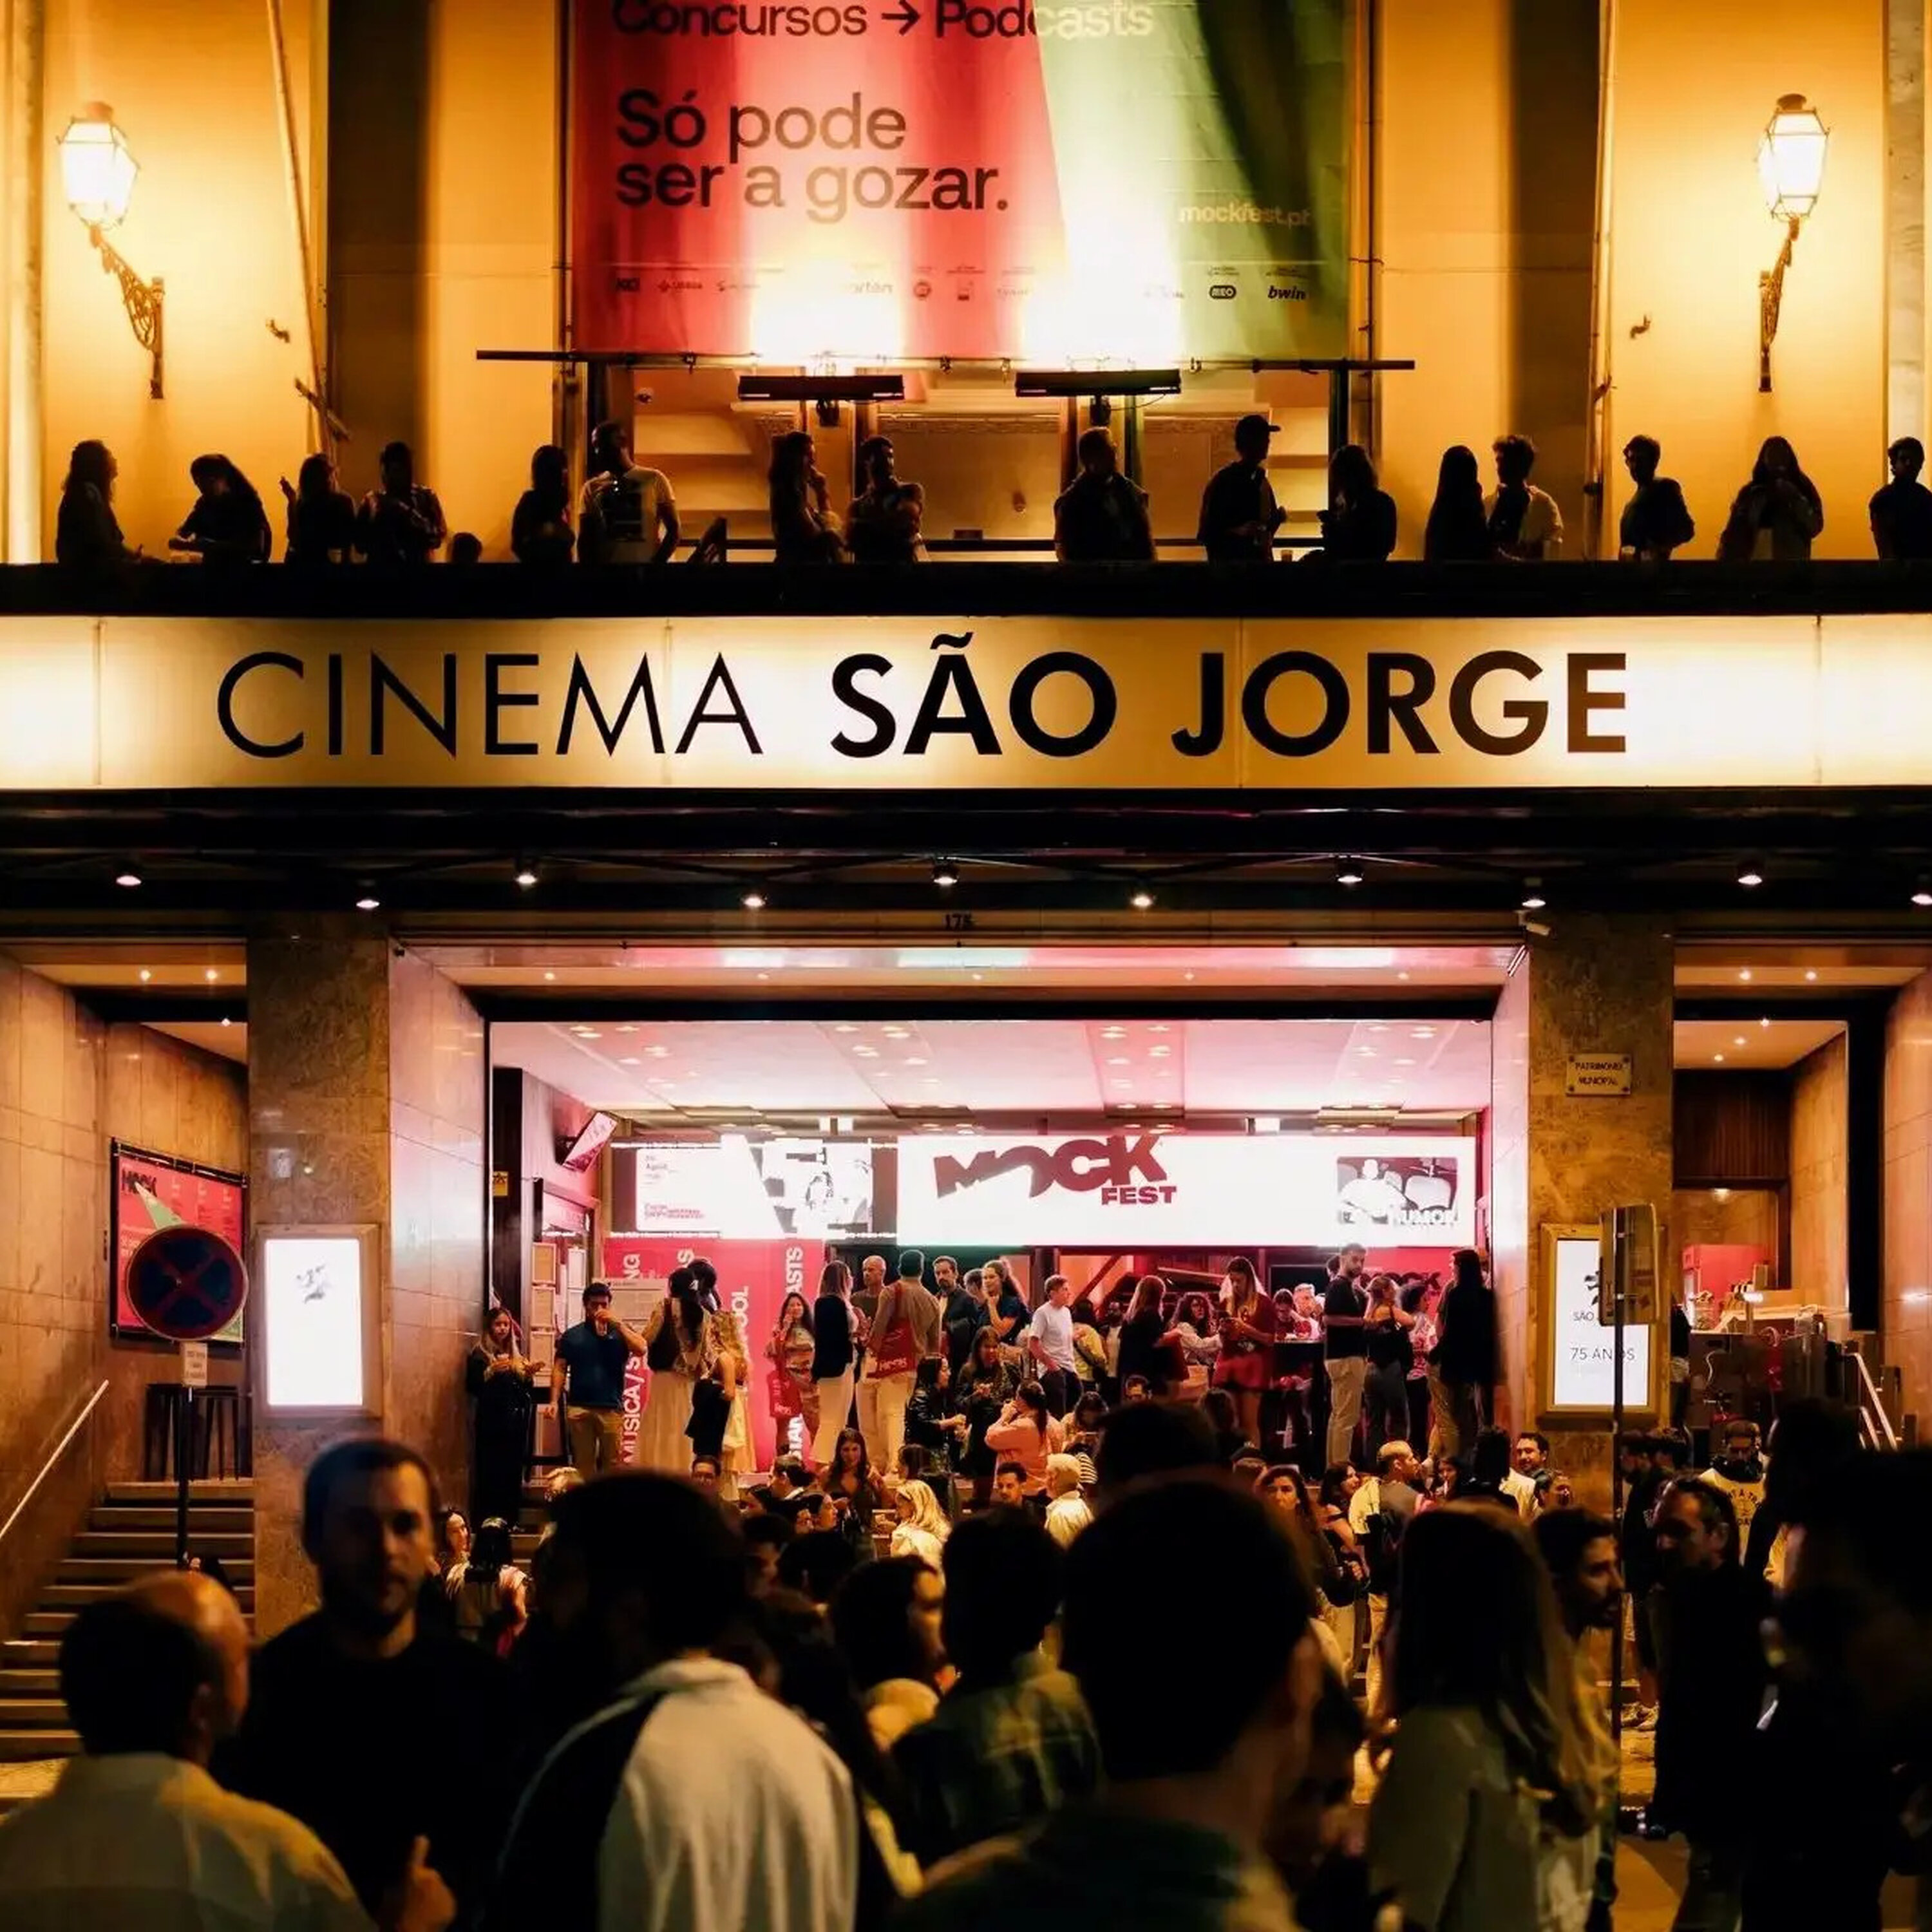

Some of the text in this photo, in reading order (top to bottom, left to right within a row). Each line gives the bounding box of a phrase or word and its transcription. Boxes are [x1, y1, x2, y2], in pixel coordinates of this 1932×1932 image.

[612, 0, 1153, 39] Concursos Podcasts
[617, 89, 906, 164] Só pode
[616, 162, 1008, 223] ser a gozar.
[1267, 285, 1306, 299] bwin
[217, 632, 1626, 759] CINEMA SÃO JORGE
[933, 1135, 1168, 1198] MOCK
[1101, 1186, 1177, 1205] FEST
[1571, 1347, 1635, 1361] 75 ANS
